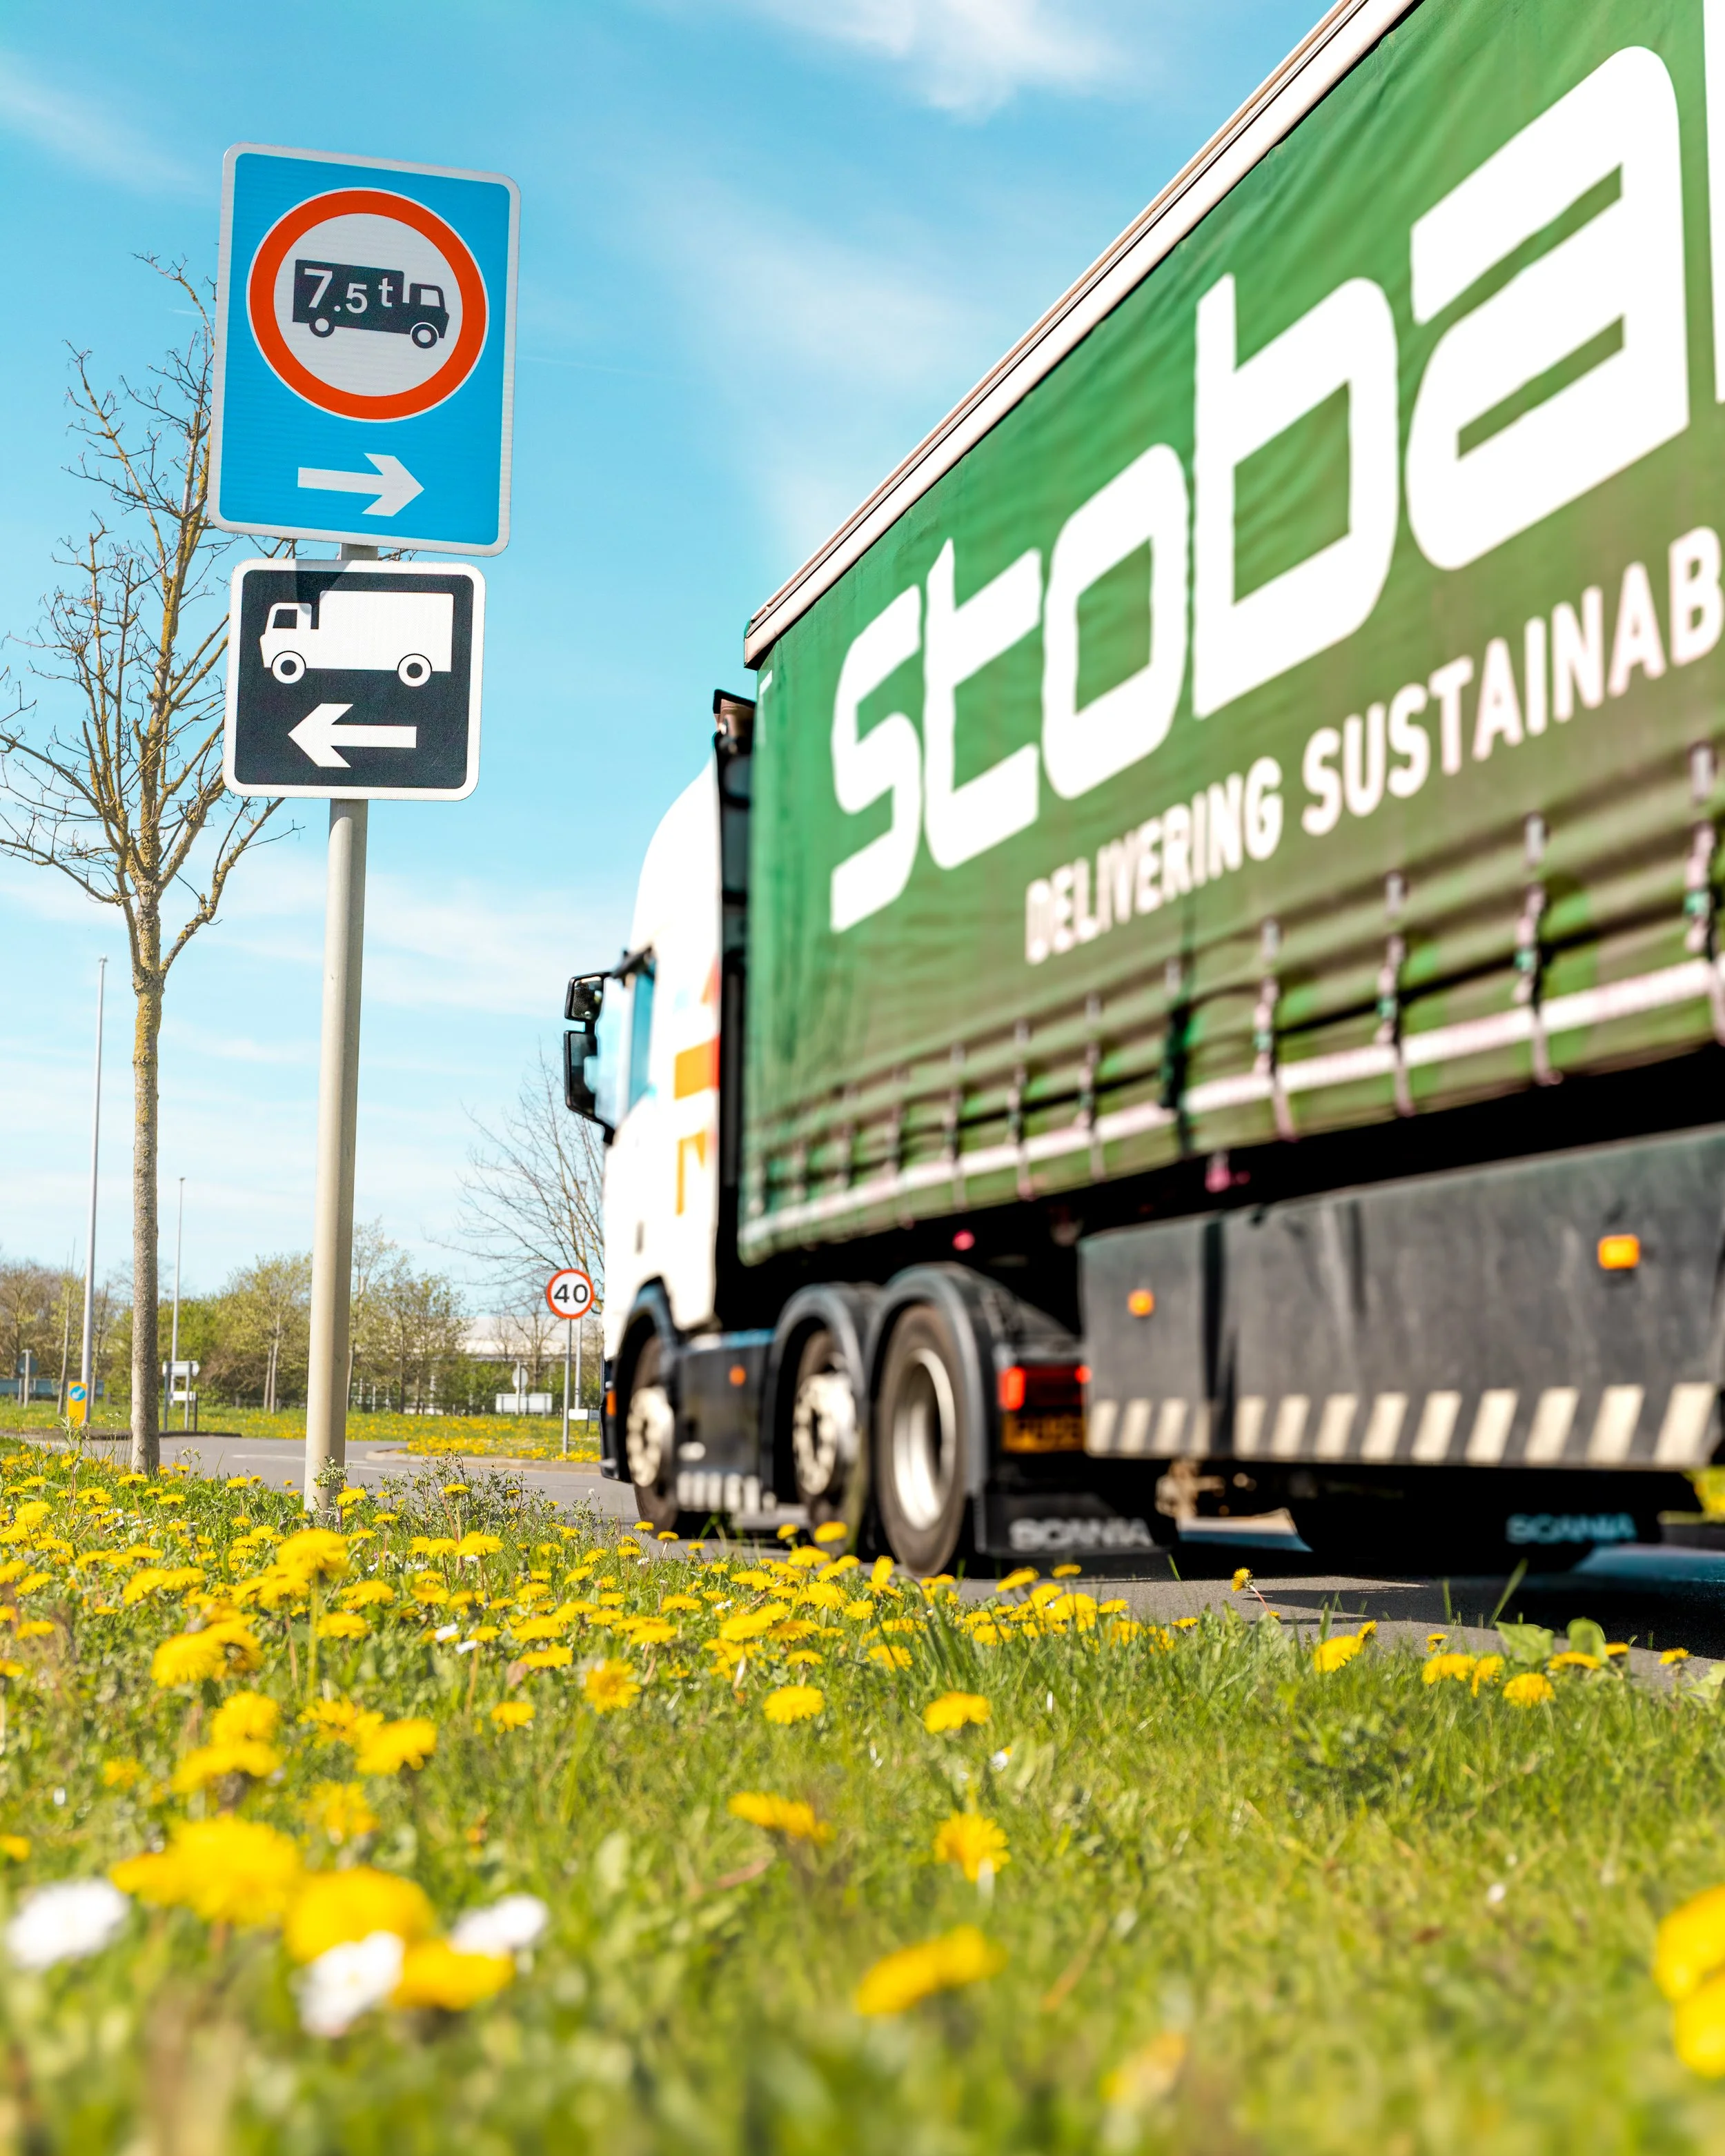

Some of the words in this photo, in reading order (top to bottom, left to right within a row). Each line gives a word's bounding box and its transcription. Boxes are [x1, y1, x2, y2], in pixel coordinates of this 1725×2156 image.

[831, 0, 1725, 933] stoba
[1025, 755, 1283, 965] DELIVERING
[1301, 525, 1724, 835] SUSTAINAB
[553, 1283, 589, 1304] 40
